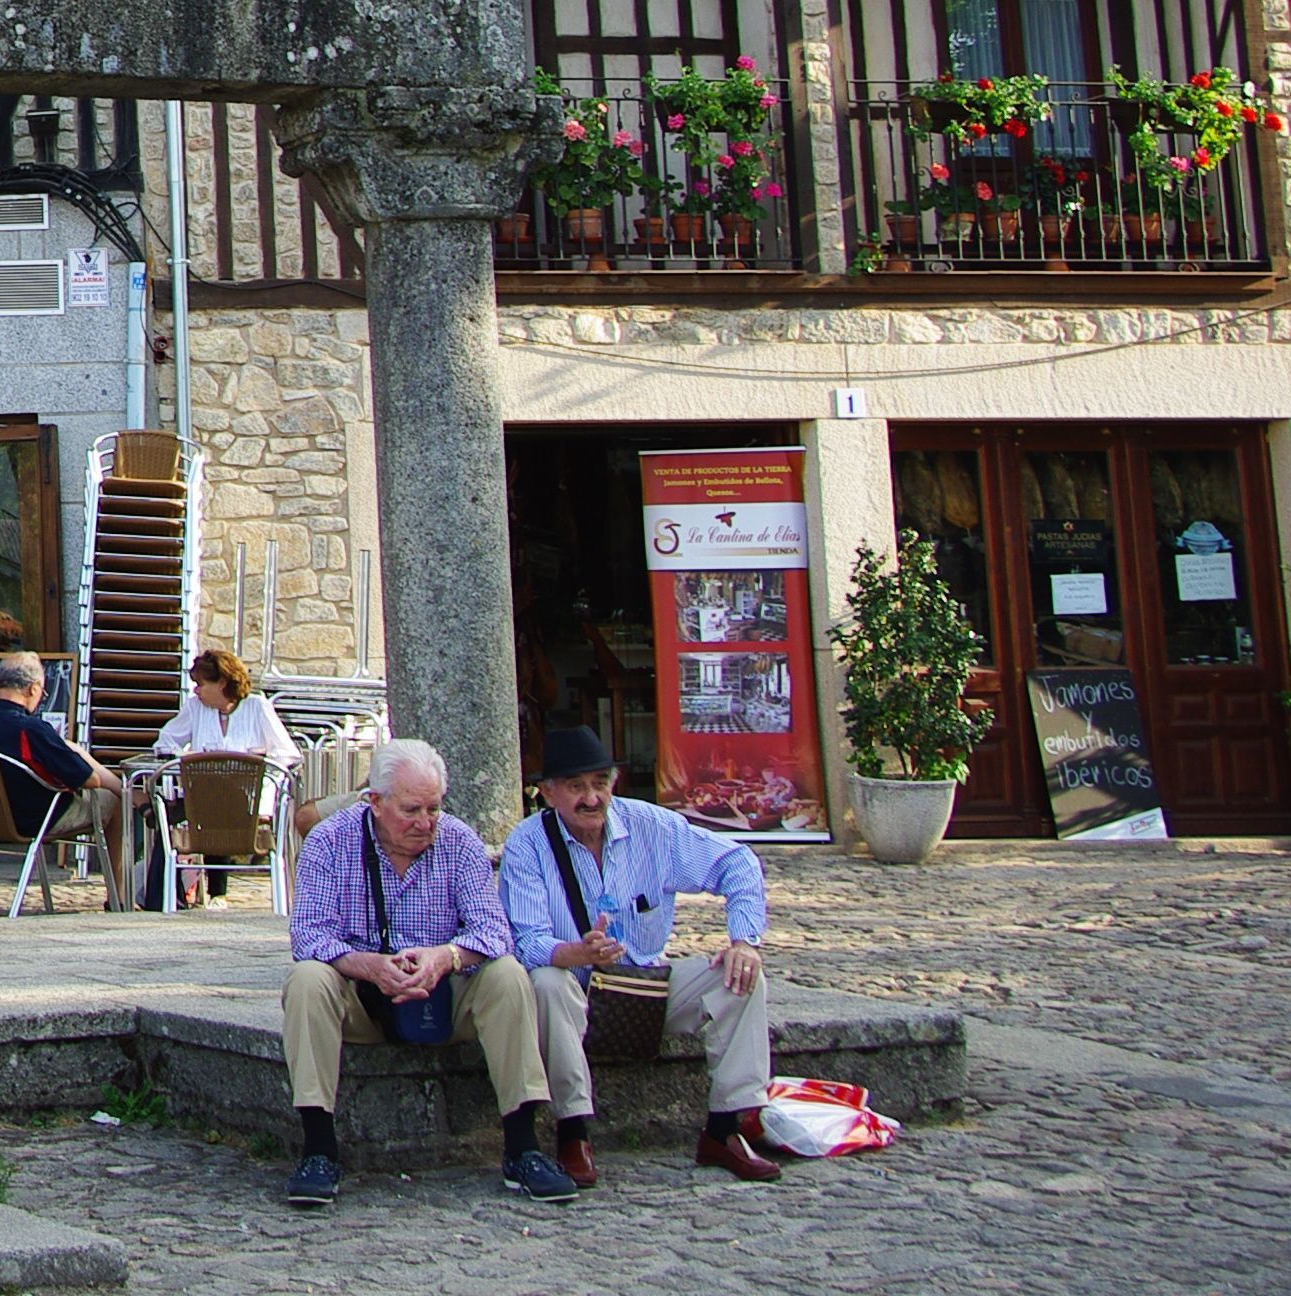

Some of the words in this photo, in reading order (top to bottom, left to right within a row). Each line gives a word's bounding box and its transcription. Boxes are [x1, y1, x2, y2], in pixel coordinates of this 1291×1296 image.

[847, 395, 854, 413] 1
[653, 467, 680, 476] VENTA
[682, 467, 692, 475] DE
[693, 467, 739, 475] PRODUCTOS
[741, 466, 751, 474] DE
[752, 466, 763, 474] LA
[764, 465, 792, 473] TIERRA
[663, 478, 696, 487] Jamones
[703, 477, 743, 486] Embutidos
[744, 477, 754, 485] de
[686, 527, 702, 543] La
[708, 525, 753, 544] Cantina
[757, 525, 770, 542] de
[1035, 532, 1069, 541] PASTAS
[767, 547, 799, 555] TIENDA
[1043, 541, 1096, 549] ARTESANAS
[1038, 674, 1134, 713] Jamones
[1044, 727, 1140, 755] embutidos
[1056, 760, 1153, 789] ibéricos
